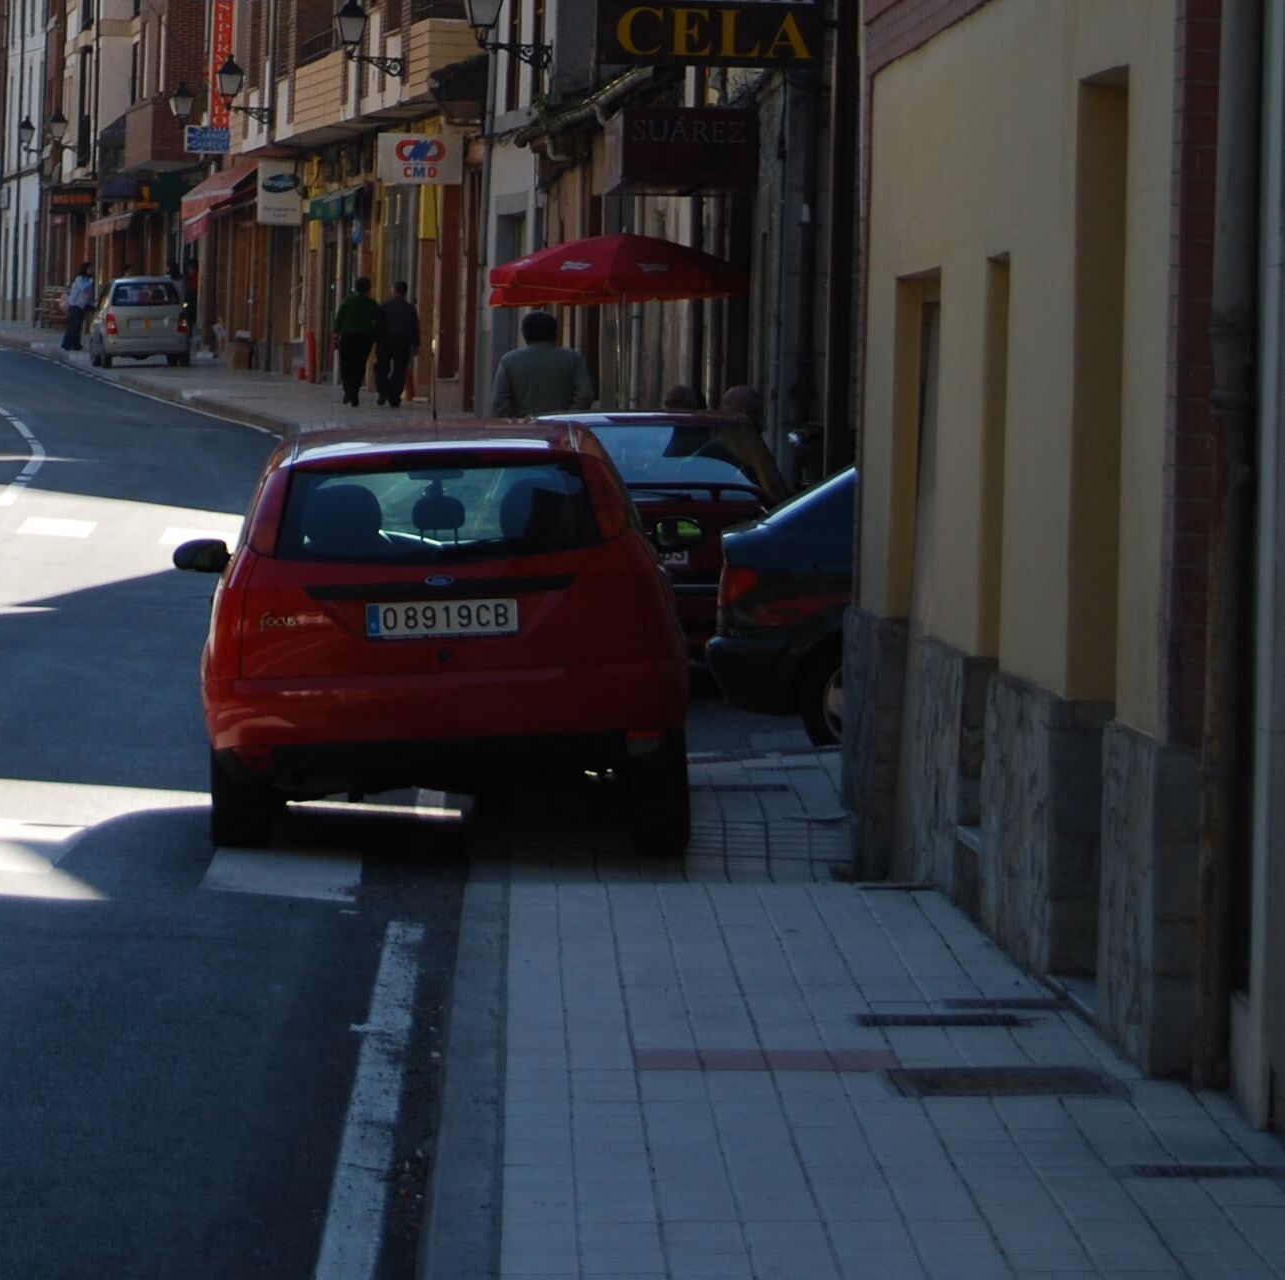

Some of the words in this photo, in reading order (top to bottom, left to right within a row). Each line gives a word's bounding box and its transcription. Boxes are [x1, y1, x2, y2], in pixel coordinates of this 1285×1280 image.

[616, 6, 812, 60] CELA
[632, 115, 747, 145] SUÁREZ
[403, 166, 437, 178] CMD
